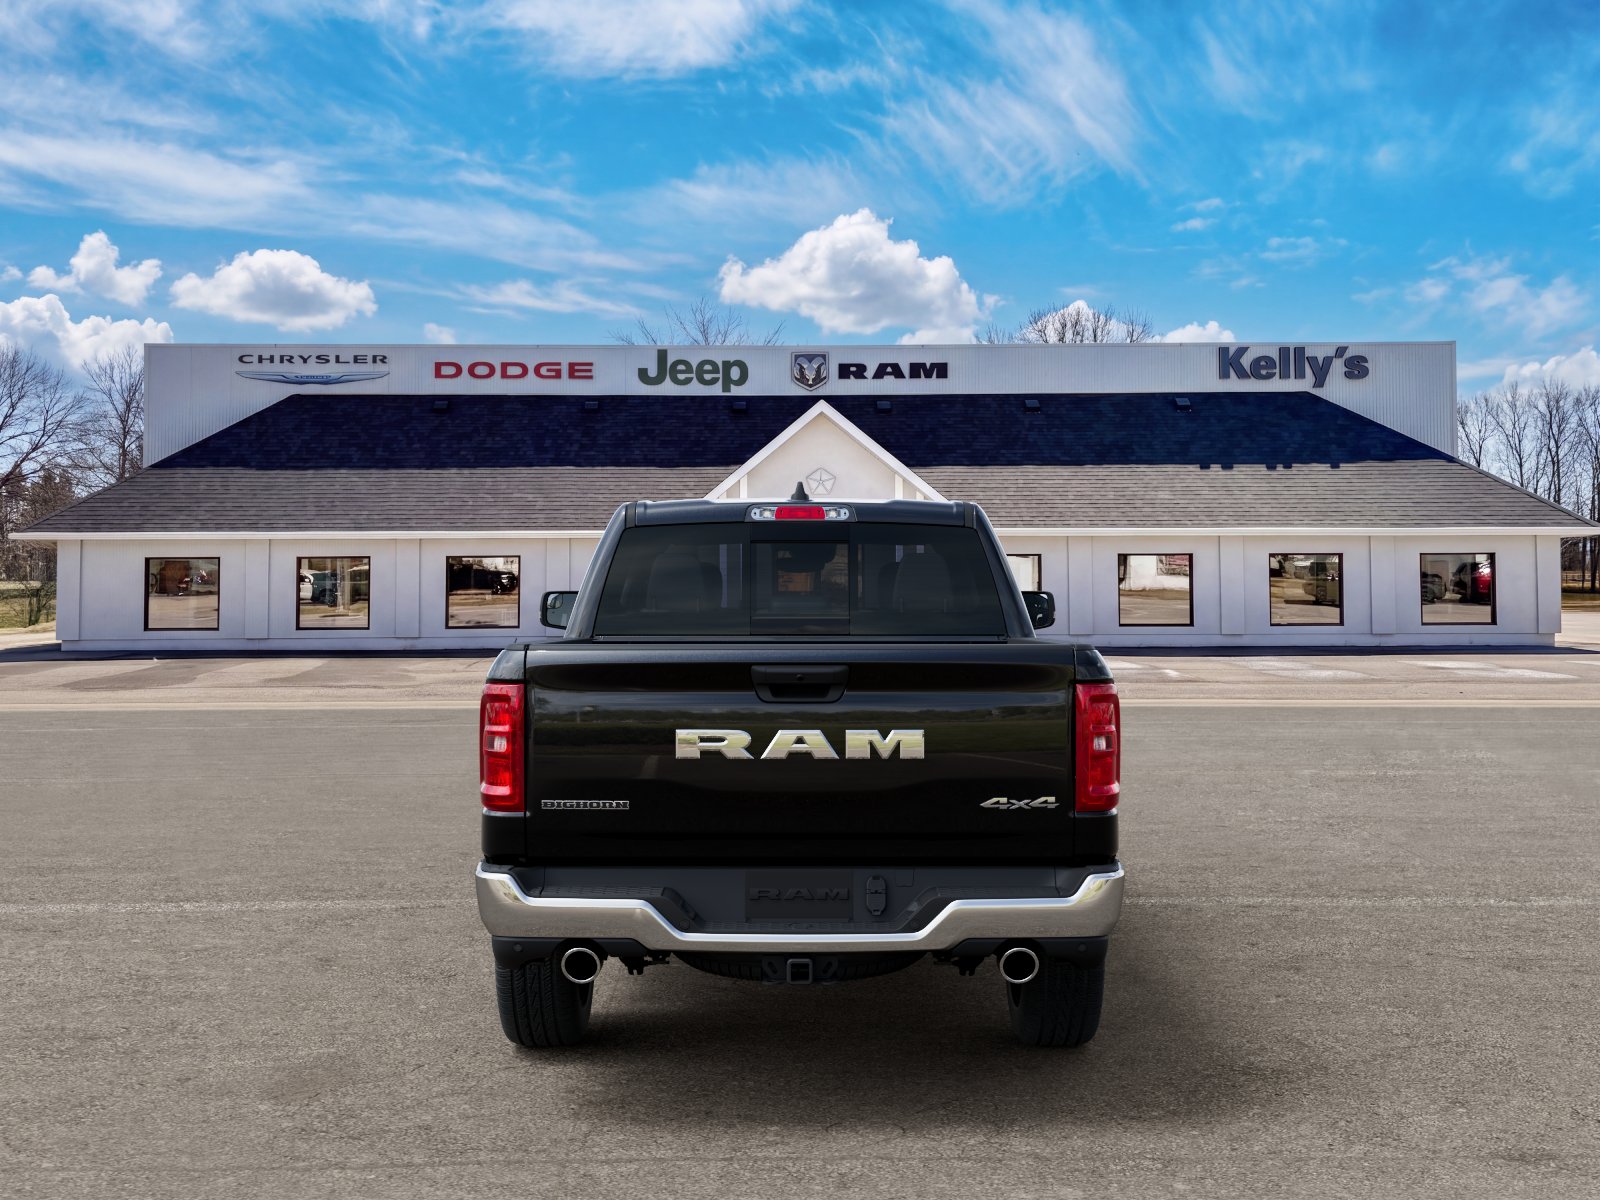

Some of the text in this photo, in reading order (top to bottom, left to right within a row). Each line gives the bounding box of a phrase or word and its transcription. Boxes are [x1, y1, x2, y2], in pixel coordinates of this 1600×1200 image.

[238, 354, 388, 364] CHRYSLER
[1218, 346, 1370, 388] Kelly's
[434, 361, 594, 379] DODGE
[637, 349, 749, 393] Jeep
[838, 362, 948, 380] RAM
[675, 729, 925, 760] RAM
[541, 800, 630, 810] BIGHORN
[979, 796, 1060, 810] 4x4
[749, 888, 850, 901] RAM
